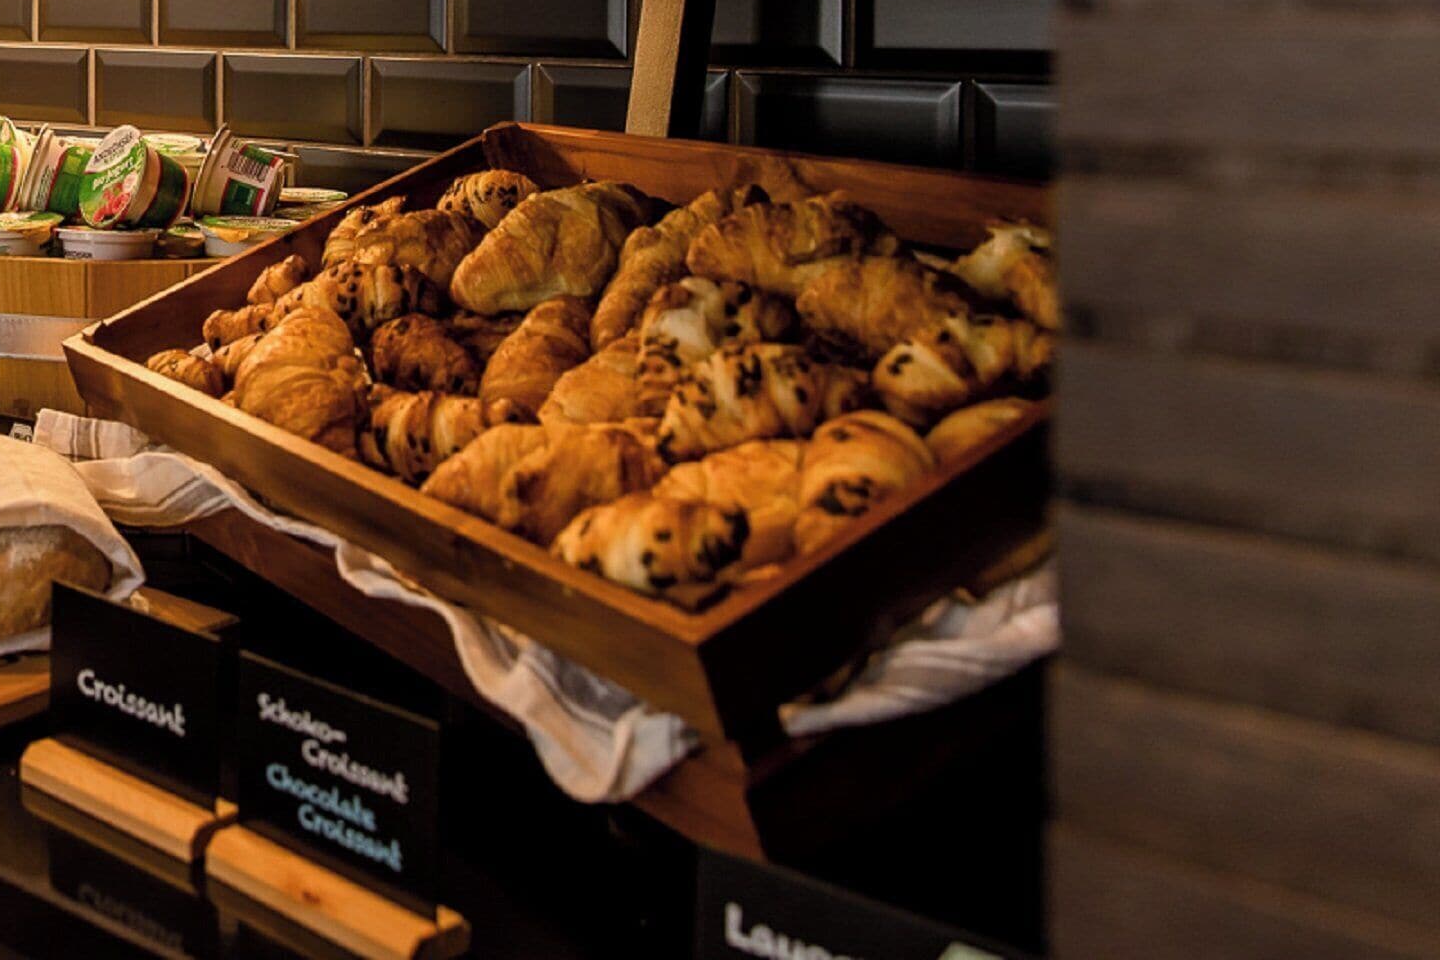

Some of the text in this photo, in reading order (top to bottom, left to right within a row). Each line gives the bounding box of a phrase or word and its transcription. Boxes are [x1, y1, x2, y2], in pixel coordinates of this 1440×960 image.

[76, 668, 187, 738] Croissant
[257, 692, 348, 744] Schoko-
[265, 762, 378, 831] Chocolate
[301, 739, 410, 804] Croissant
[297, 806, 404, 873] Croissant
